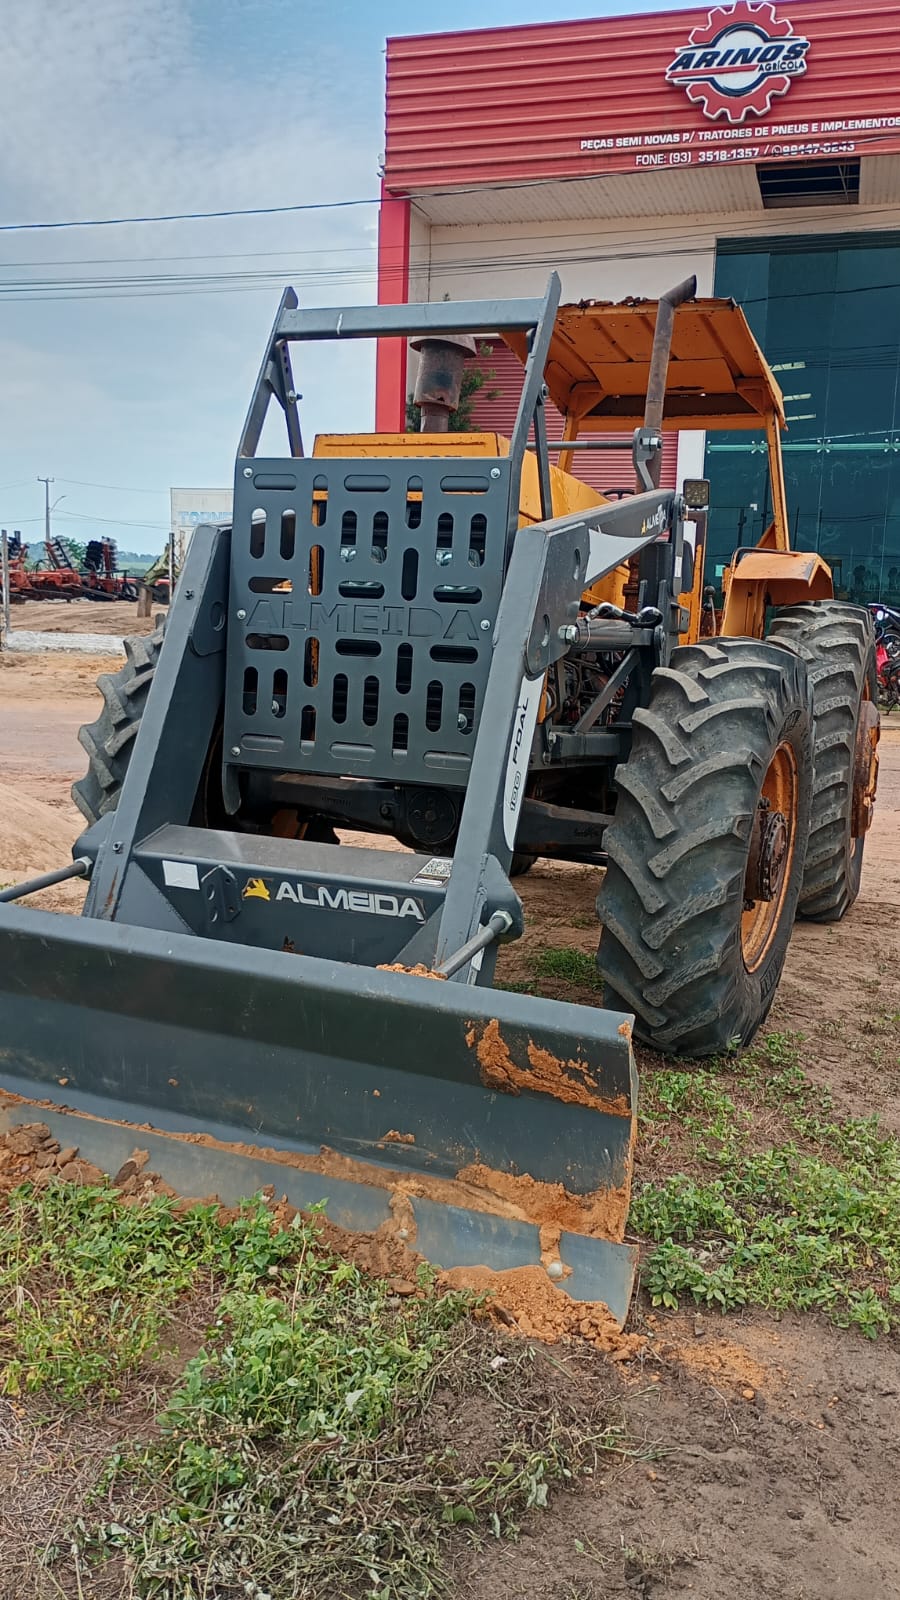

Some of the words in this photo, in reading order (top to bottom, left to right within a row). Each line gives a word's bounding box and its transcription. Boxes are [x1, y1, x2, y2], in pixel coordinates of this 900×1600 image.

[668, 42, 810, 71] ARINOS
[758, 60, 805, 72] AGRÍCOLA
[580, 138, 614, 150] PEÇAS
[616, 136, 642, 147] SEMI
[644, 133, 680, 145] NOVAS
[682, 131, 695, 143] P/
[698, 128, 753, 141] TRATORES
[754, 126, 769, 137] DE
[771, 123, 809, 135] PNEUS
[811, 122, 819, 132] E
[635, 152, 667, 166] FONE:
[669, 151, 692, 165] (93)
[698, 147, 760, 162] 3518-1357
[246, 600, 480, 641] ALMEIDA
[513, 697, 529, 764] PDAL
[275, 881, 425, 921] ALMEIDA
